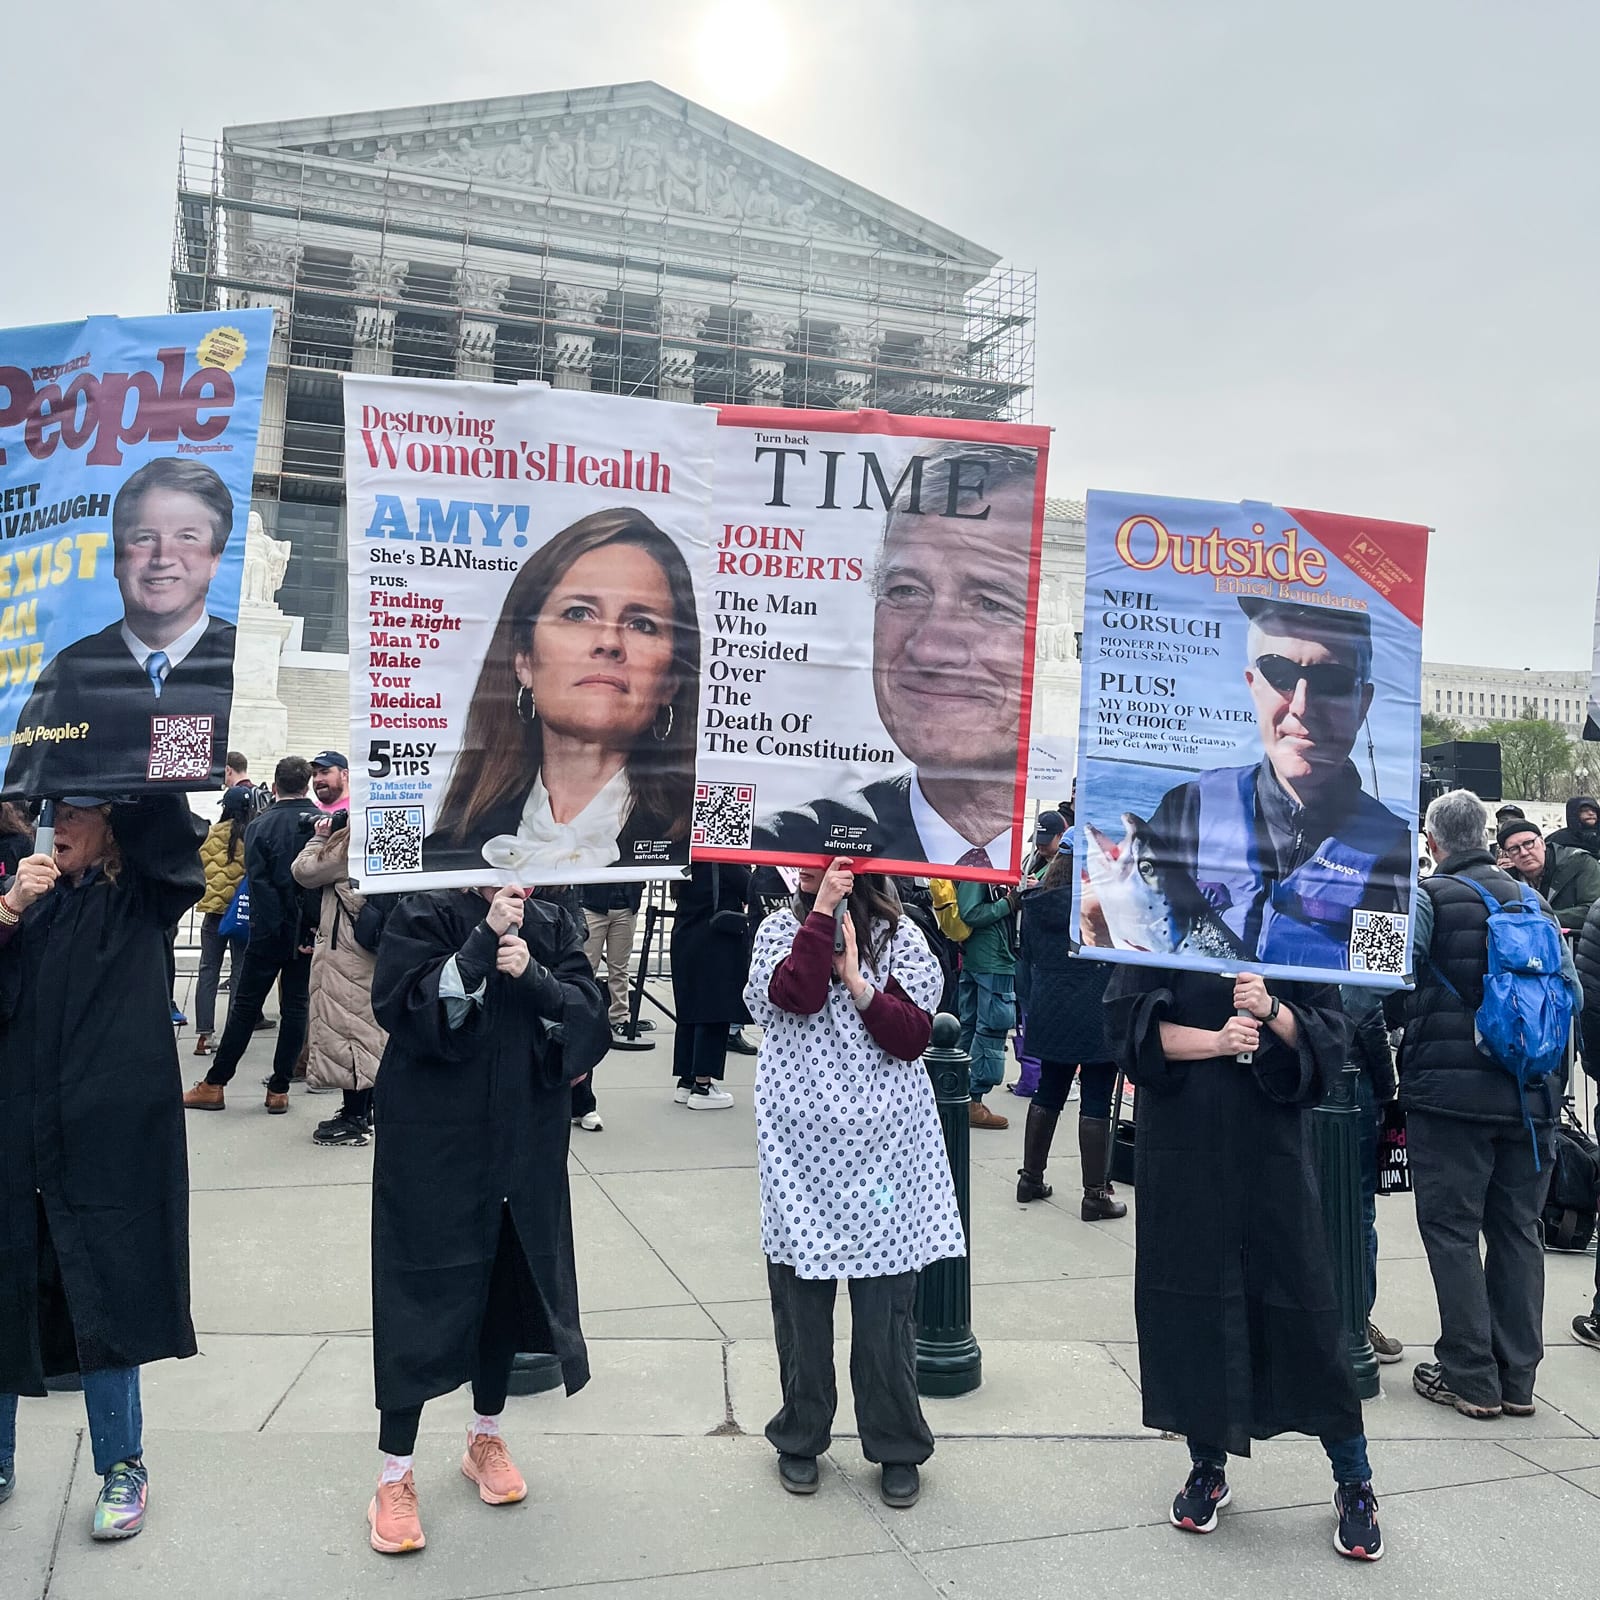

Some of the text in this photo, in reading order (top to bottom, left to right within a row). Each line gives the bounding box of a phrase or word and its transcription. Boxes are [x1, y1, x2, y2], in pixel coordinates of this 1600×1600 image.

[0, 347, 236, 466] People
[362, 404, 496, 445] Destroying
[755, 432, 809, 446] Turn back
[755, 446, 992, 521] TIME
[365, 494, 530, 549] AMY!
[717, 524, 805, 551] JOHN
[370, 547, 518, 573] She's BANtastic
[1115, 513, 1328, 587] Outside
[717, 551, 863, 582] ROBERTS
[1343, 553, 1392, 597] aafront.org
[370, 575, 408, 588] PLUS:
[369, 591, 444, 613] Finding
[715, 590, 817, 616] The Man
[1103, 589, 1159, 611] NEIL
[1215, 577, 1369, 610] Ethical Boundaries
[369, 611, 461, 633] The Right
[714, 614, 767, 636] Who
[1102, 611, 1222, 639] GORSUCH
[369, 631, 440, 649] Man To
[711, 637, 808, 662] Presided
[1100, 637, 1220, 657] PIONEER IN STOLEN
[369, 652, 421, 669] Make
[1099, 647, 1189, 665] SCOTUS SEATS
[369, 672, 411, 688] Your
[709, 660, 766, 683] Over
[708, 684, 751, 706] The
[1100, 671, 1177, 698] PLUS!
[369, 692, 442, 709] Medical
[1098, 697, 1257, 726] MY BODY OF WATER,
[369, 712, 448, 729] Decisons
[705, 708, 813, 733] Death Of
[1097, 711, 1187, 731] MY CHOICE
[35, 722, 89, 744] People?
[1097, 726, 1237, 748] The Supreme Court Getaways
[705, 732, 895, 763] The Constitution
[1097, 736, 1199, 755] They Get Away With!
[368, 740, 436, 778] 5 EASY
[392, 761, 430, 776] TIPS
[370, 781, 432, 791] To Master the
[370, 790, 423, 801] Blank Stare
[634, 853, 670, 861] aafront.org
[824, 840, 872, 853] aafront.org
[1389, 1148, 1408, 1167] for
[1381, 1169, 1402, 1188] will
